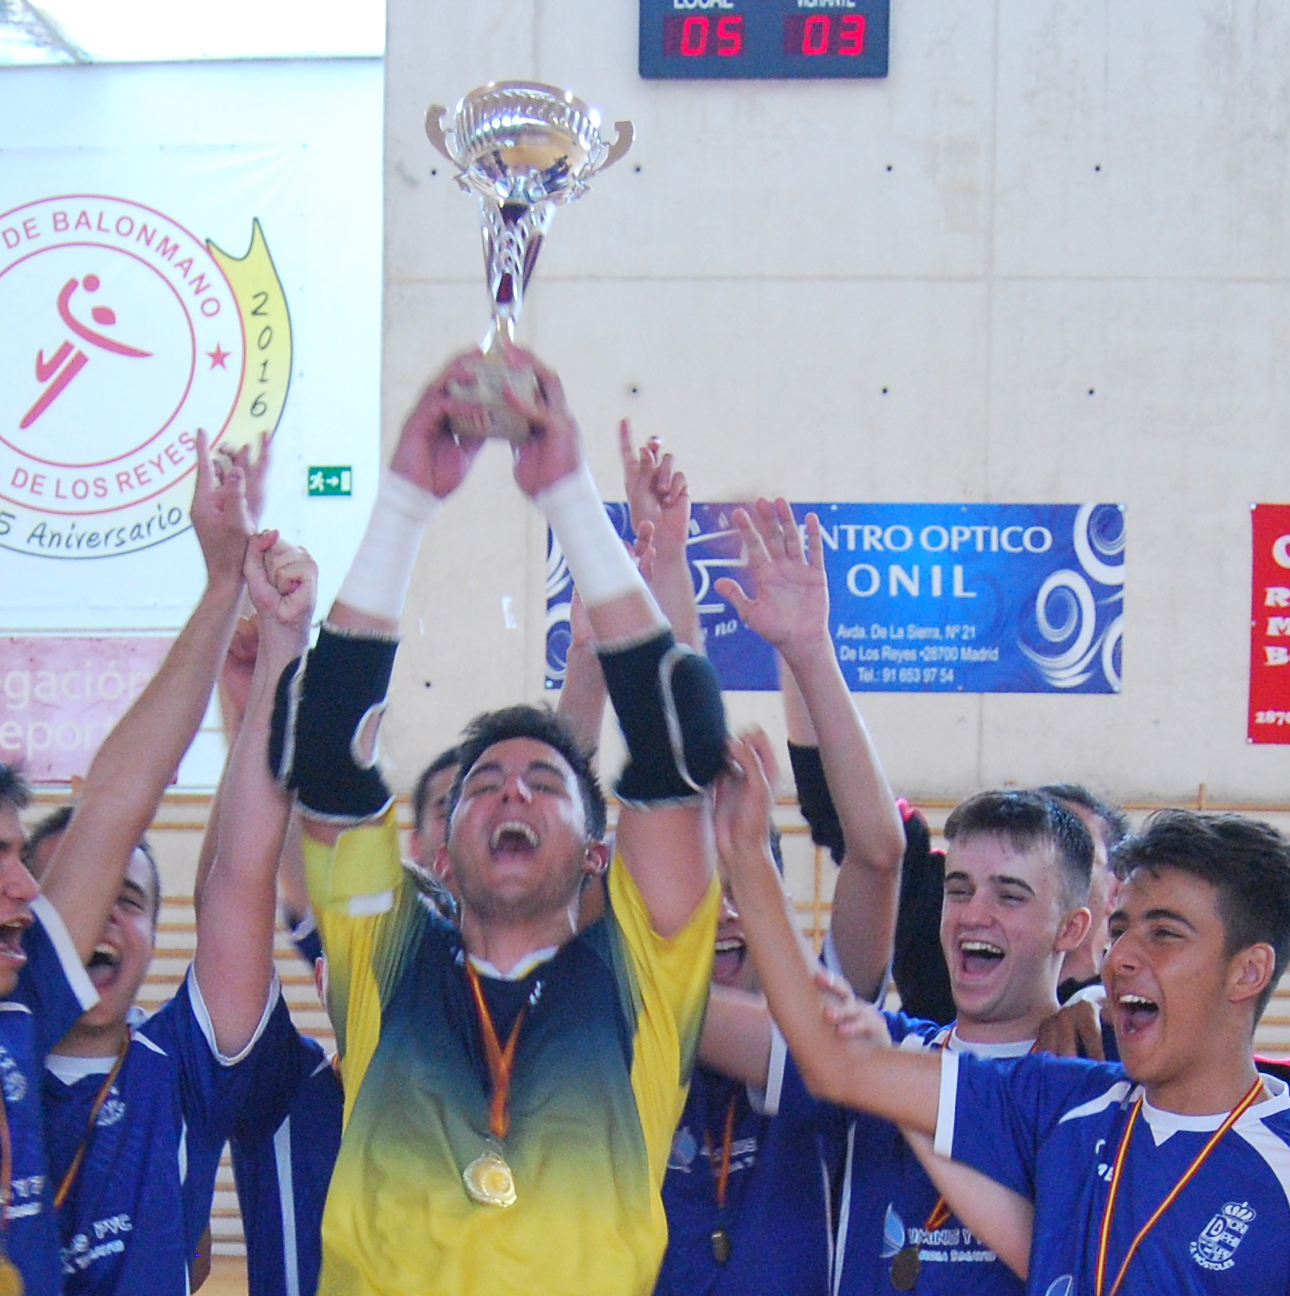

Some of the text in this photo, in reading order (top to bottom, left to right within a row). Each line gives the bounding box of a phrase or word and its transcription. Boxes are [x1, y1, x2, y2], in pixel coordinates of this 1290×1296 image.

[681, 16, 744, 56] 05
[802, 15, 866, 55] 03
[1, 217, 41, 250] DE
[52, 210, 222, 318] BALONMANO
[10, 467, 46, 497] DE
[55, 476, 109, 501] LOS
[116, 431, 199, 495] REYES
[27, 502, 184, 550] Aniversario
[799, 525, 1052, 553] ENTRO OPTICO
[871, 624, 888, 639] De
[890, 625, 904, 639] La
[961, 625, 976, 640] 21
[840, 646, 857, 661] De
[860, 646, 880, 661] Los
[882, 646, 917, 663] Reyes
[960, 647, 999, 662] Madrid
